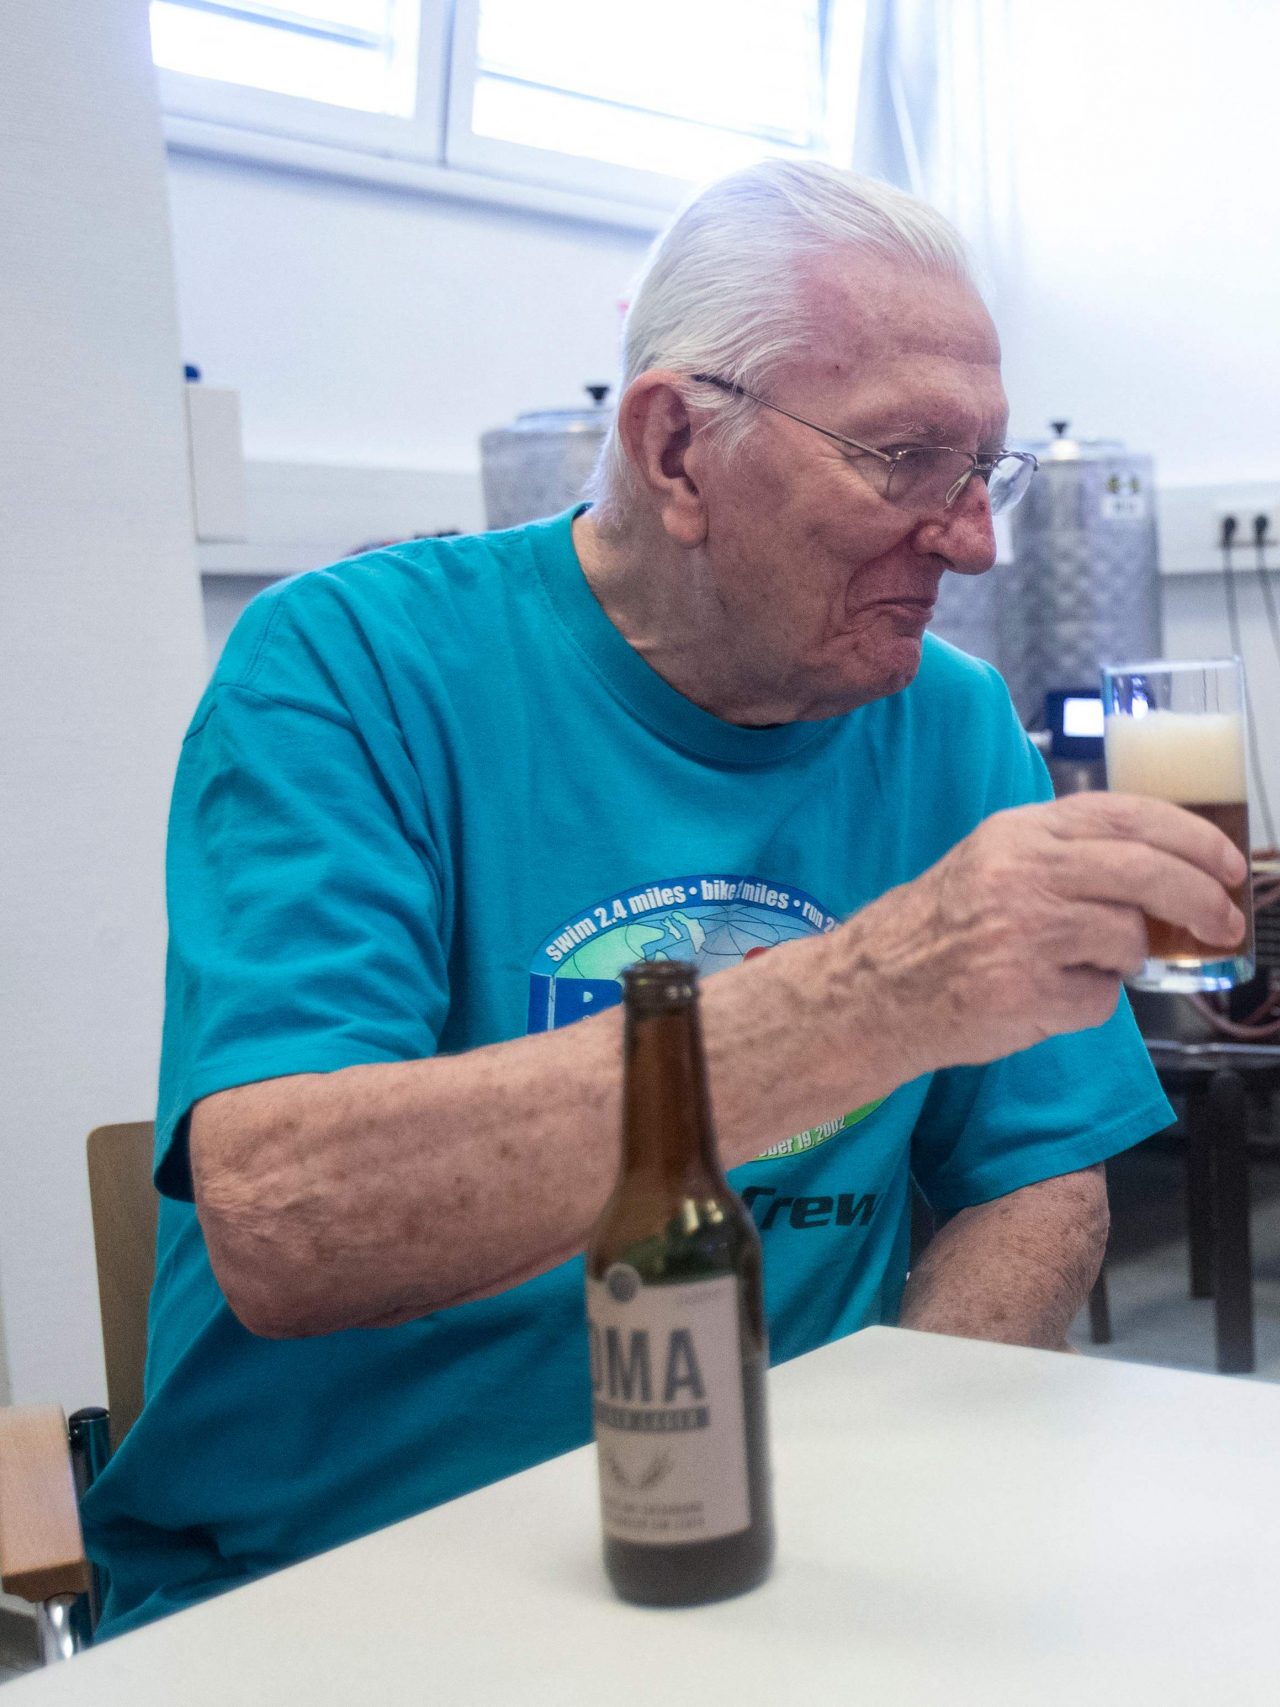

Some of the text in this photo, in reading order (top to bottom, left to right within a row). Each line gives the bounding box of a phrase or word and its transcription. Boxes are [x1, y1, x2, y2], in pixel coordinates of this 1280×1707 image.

[545, 917, 598, 962] swim
[593, 900, 628, 928] 2.4
[628, 885, 687, 915] miles
[700, 879, 736, 901] bike
[741, 883, 790, 910] miles
[801, 901, 823, 929] run
